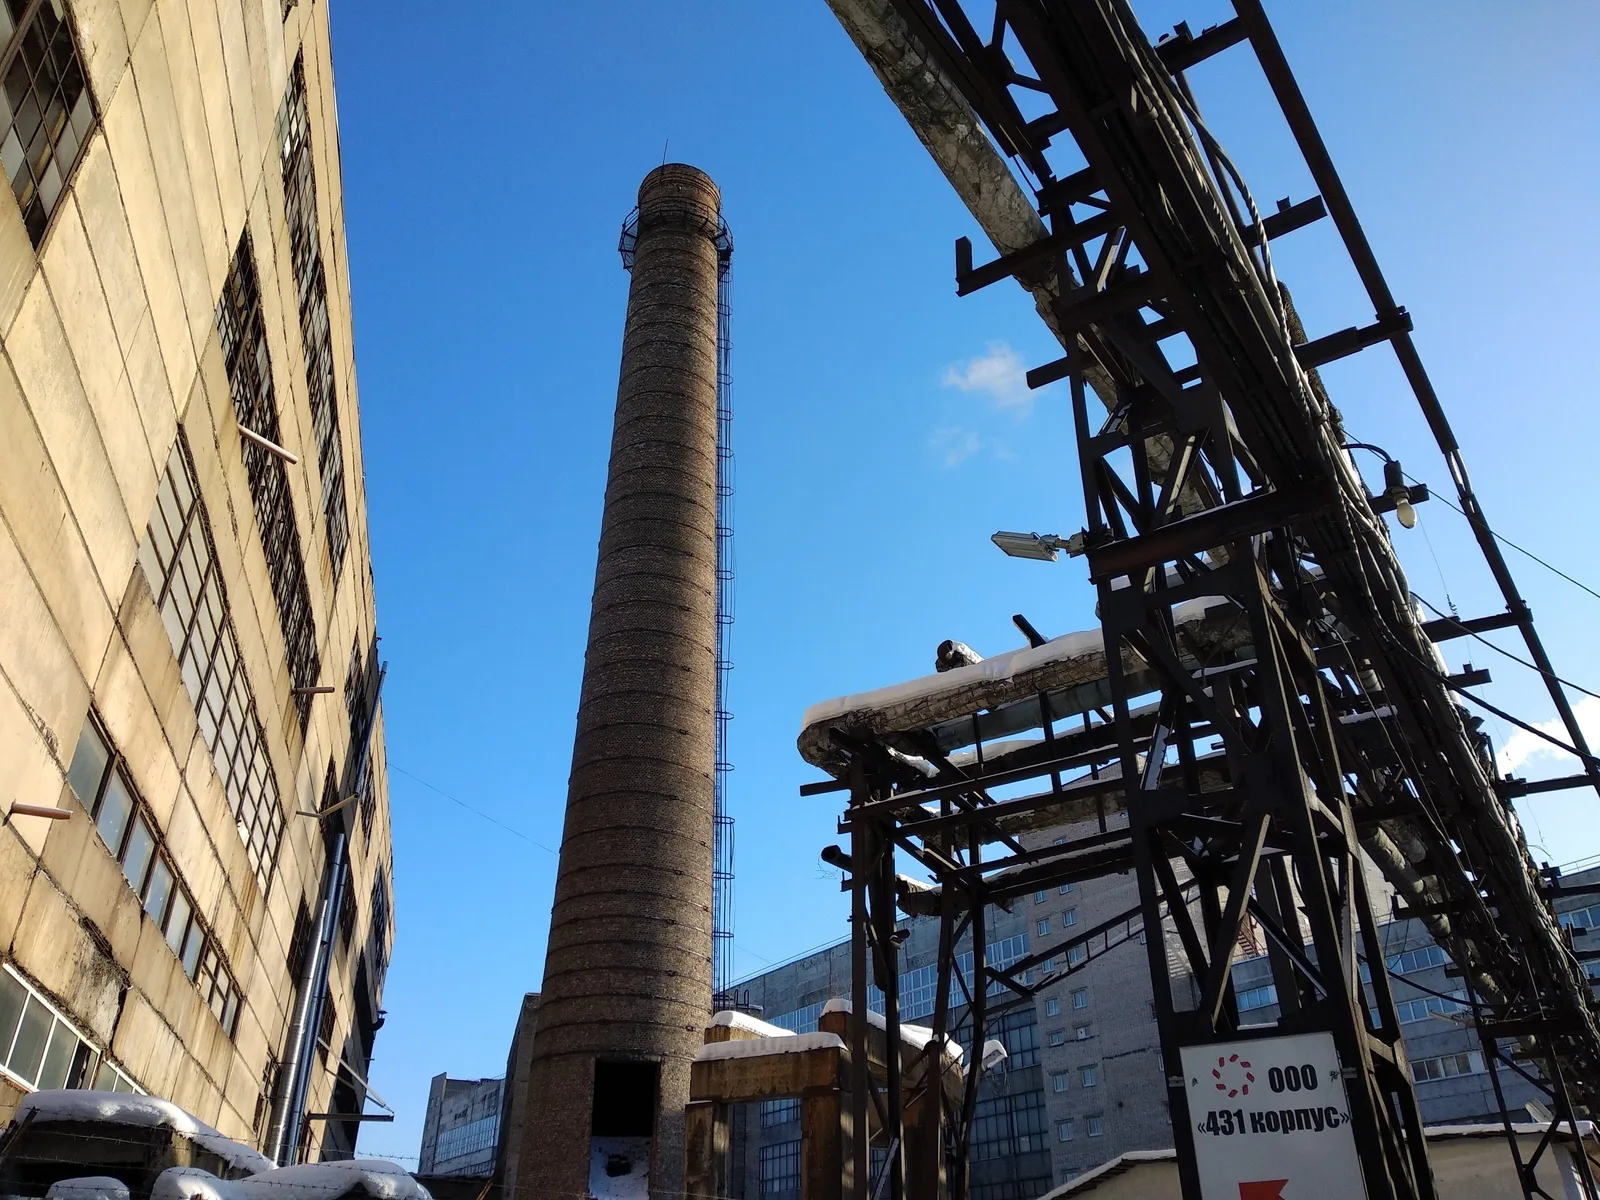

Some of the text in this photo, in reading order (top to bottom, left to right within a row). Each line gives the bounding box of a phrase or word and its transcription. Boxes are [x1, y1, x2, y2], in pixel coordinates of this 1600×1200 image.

[1268, 1064, 1318, 1093] ООО
[1197, 1106, 1350, 1136] «431 корпус»
